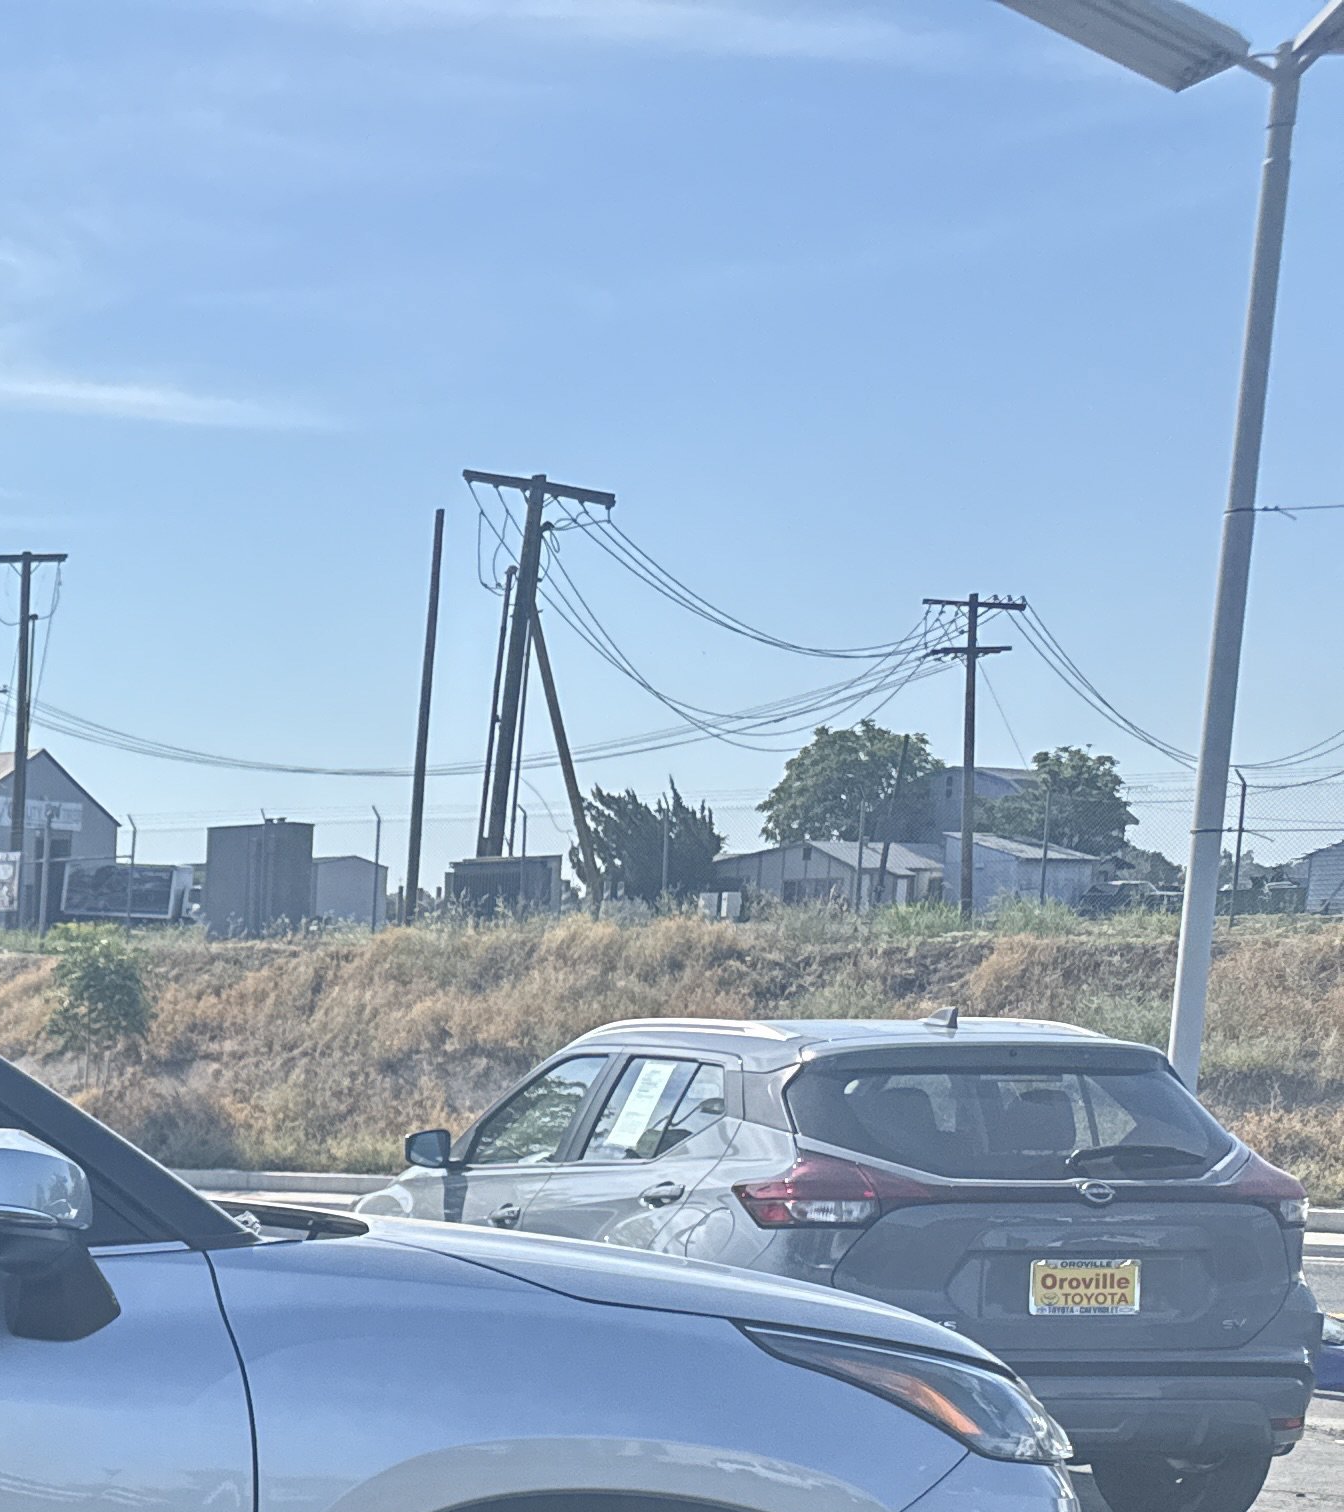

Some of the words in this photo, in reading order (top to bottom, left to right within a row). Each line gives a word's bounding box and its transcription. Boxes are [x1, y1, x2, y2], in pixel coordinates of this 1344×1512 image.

[1060, 1260, 1112, 1269] OROVILLE
[1040, 1273, 1130, 1290] Oroville
[1061, 1292, 1129, 1306] TOYOTA
[1221, 1318, 1248, 1330] SV
